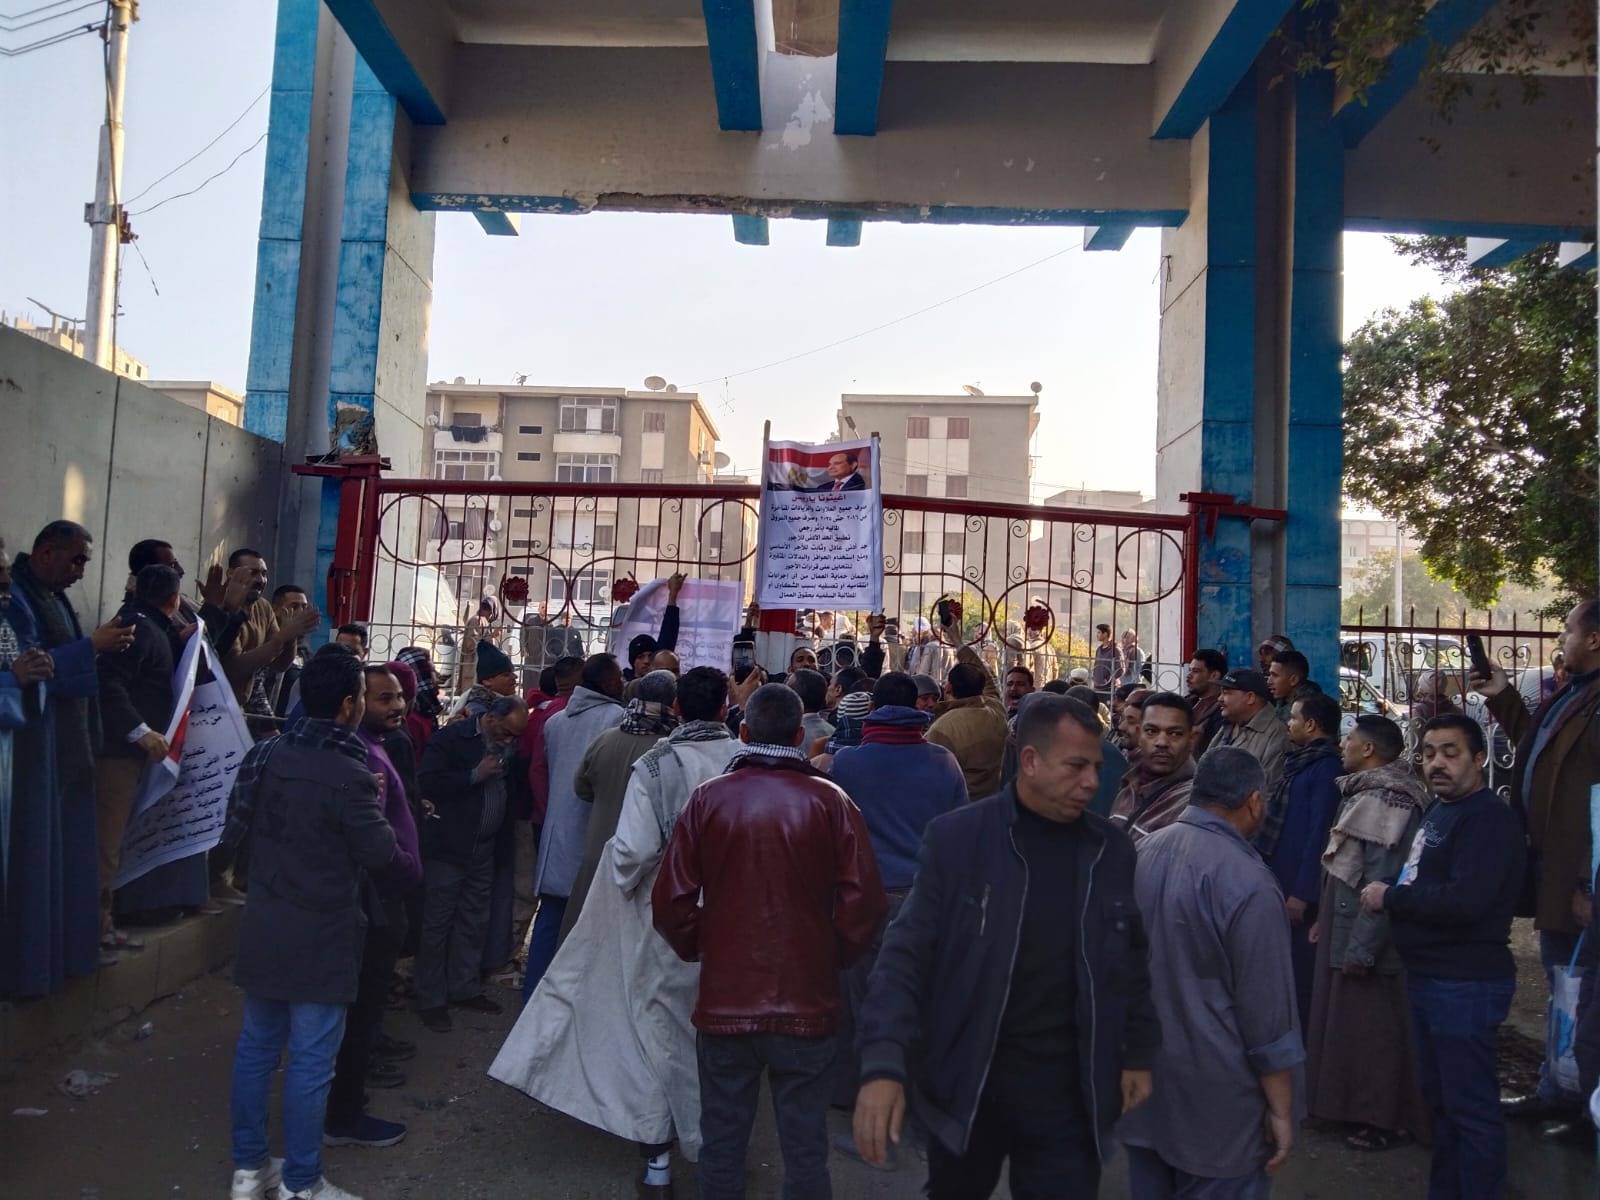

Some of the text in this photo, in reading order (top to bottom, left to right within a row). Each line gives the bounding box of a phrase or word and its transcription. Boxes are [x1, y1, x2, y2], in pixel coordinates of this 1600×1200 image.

[791, 504, 814, 513] والزيادات
[815, 504, 837, 514] العلاوات
[838, 505, 852, 513] جميع
[802, 515, 818, 523] وصرف
[834, 534, 851, 542] تطبيق
[810, 572, 828, 581] العمال
[778, 590, 797, 600] العمال
